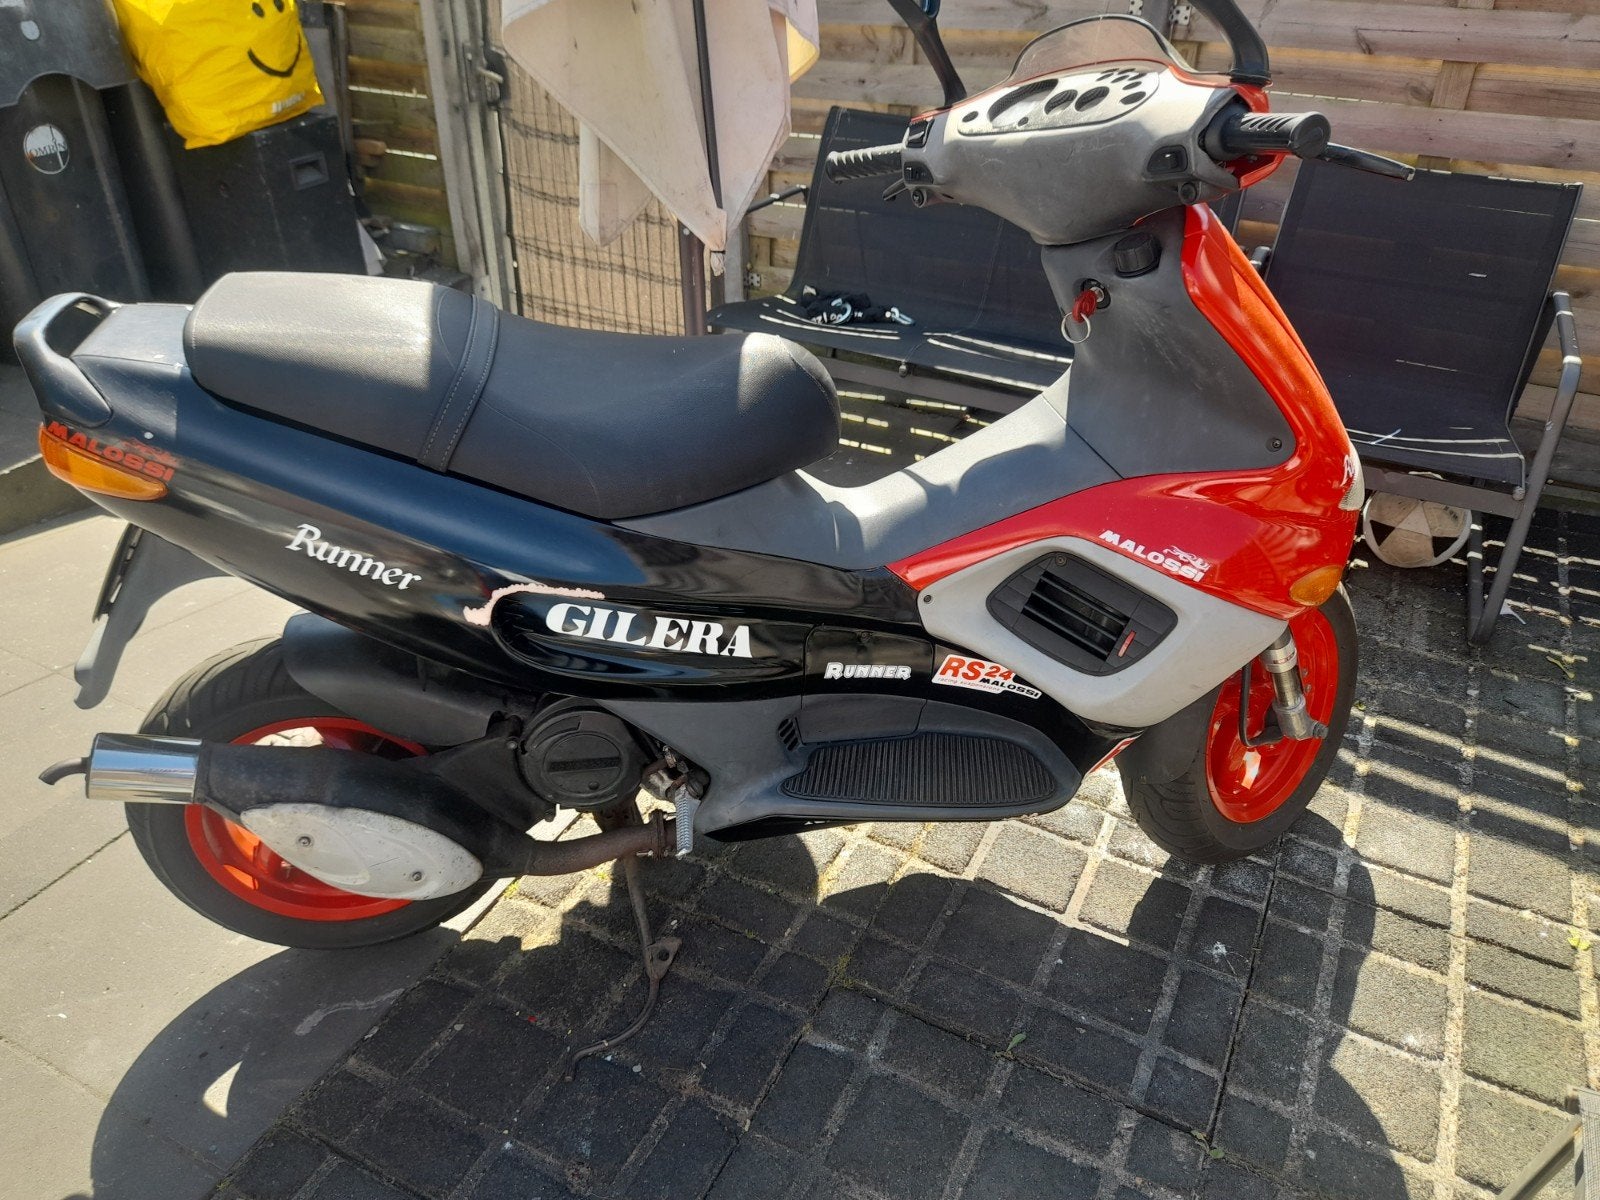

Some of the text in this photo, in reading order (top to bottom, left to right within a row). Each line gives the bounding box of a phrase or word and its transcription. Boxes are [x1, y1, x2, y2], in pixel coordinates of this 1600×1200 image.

[46, 420, 175, 482] MALOSSI
[285, 523, 422, 590] Runner
[1098, 529, 1205, 582] MALOSSI
[545, 602, 752, 658] GILERA
[979, 677, 1040, 697] MALOSSI
